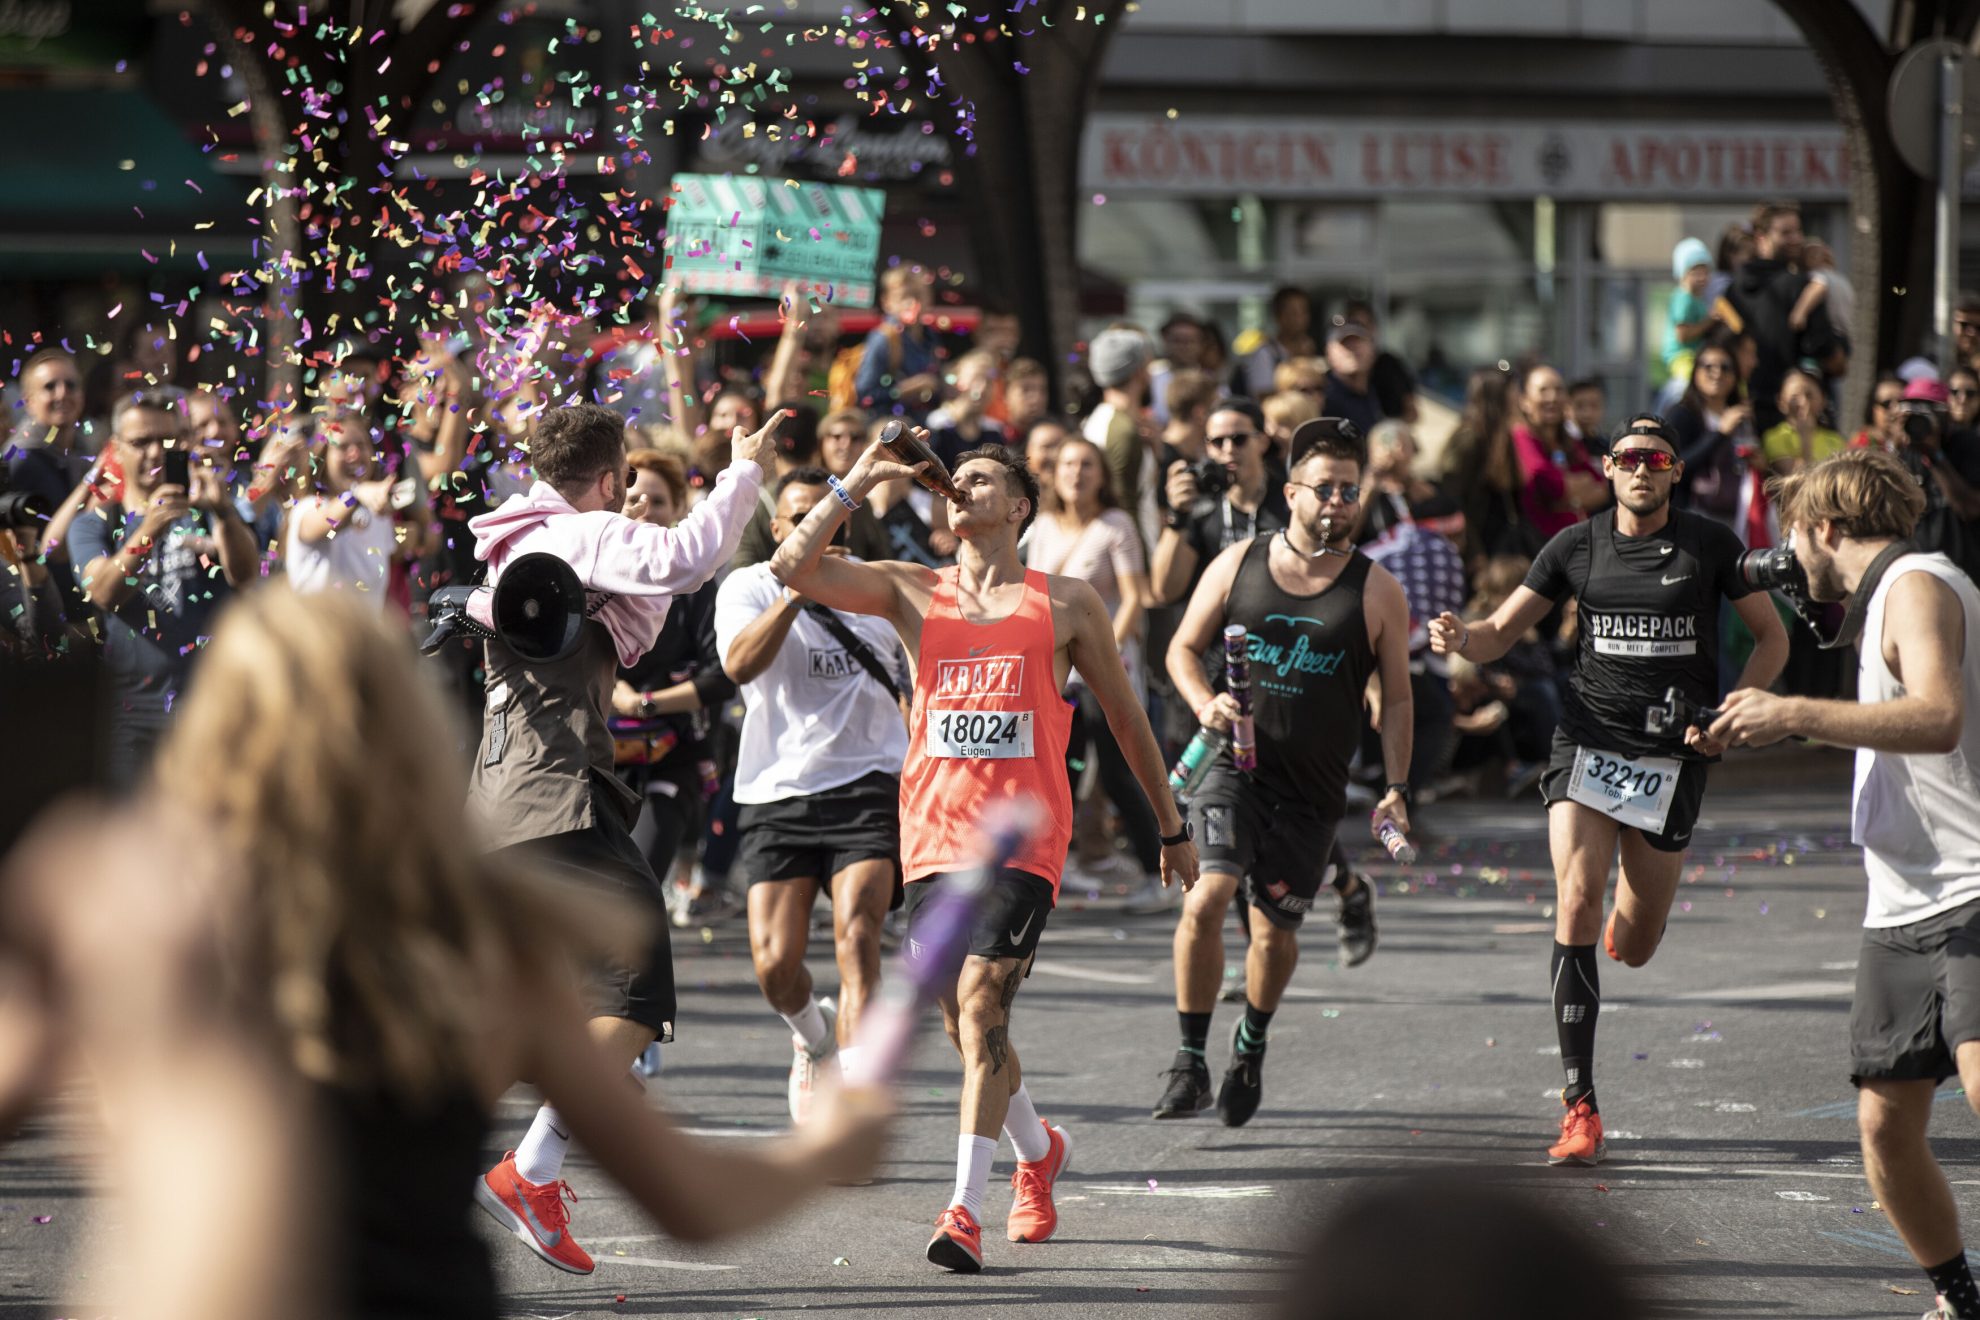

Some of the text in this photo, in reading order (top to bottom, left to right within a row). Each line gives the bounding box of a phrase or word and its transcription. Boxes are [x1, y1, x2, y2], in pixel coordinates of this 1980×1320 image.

[1103, 119, 1335, 183] KÖNIGIN
[1362, 131, 1512, 185] LUISE
[1591, 614, 1696, 638] #PACEPACK
[1650, 643, 1680, 654] COMPETE
[941, 662, 1016, 692] KRAFT.
[940, 713, 1019, 744] 18024
[1022, 713, 1029, 721] B
[960, 745, 991, 758] Eugen
[1588, 755, 1662, 797] 32210
